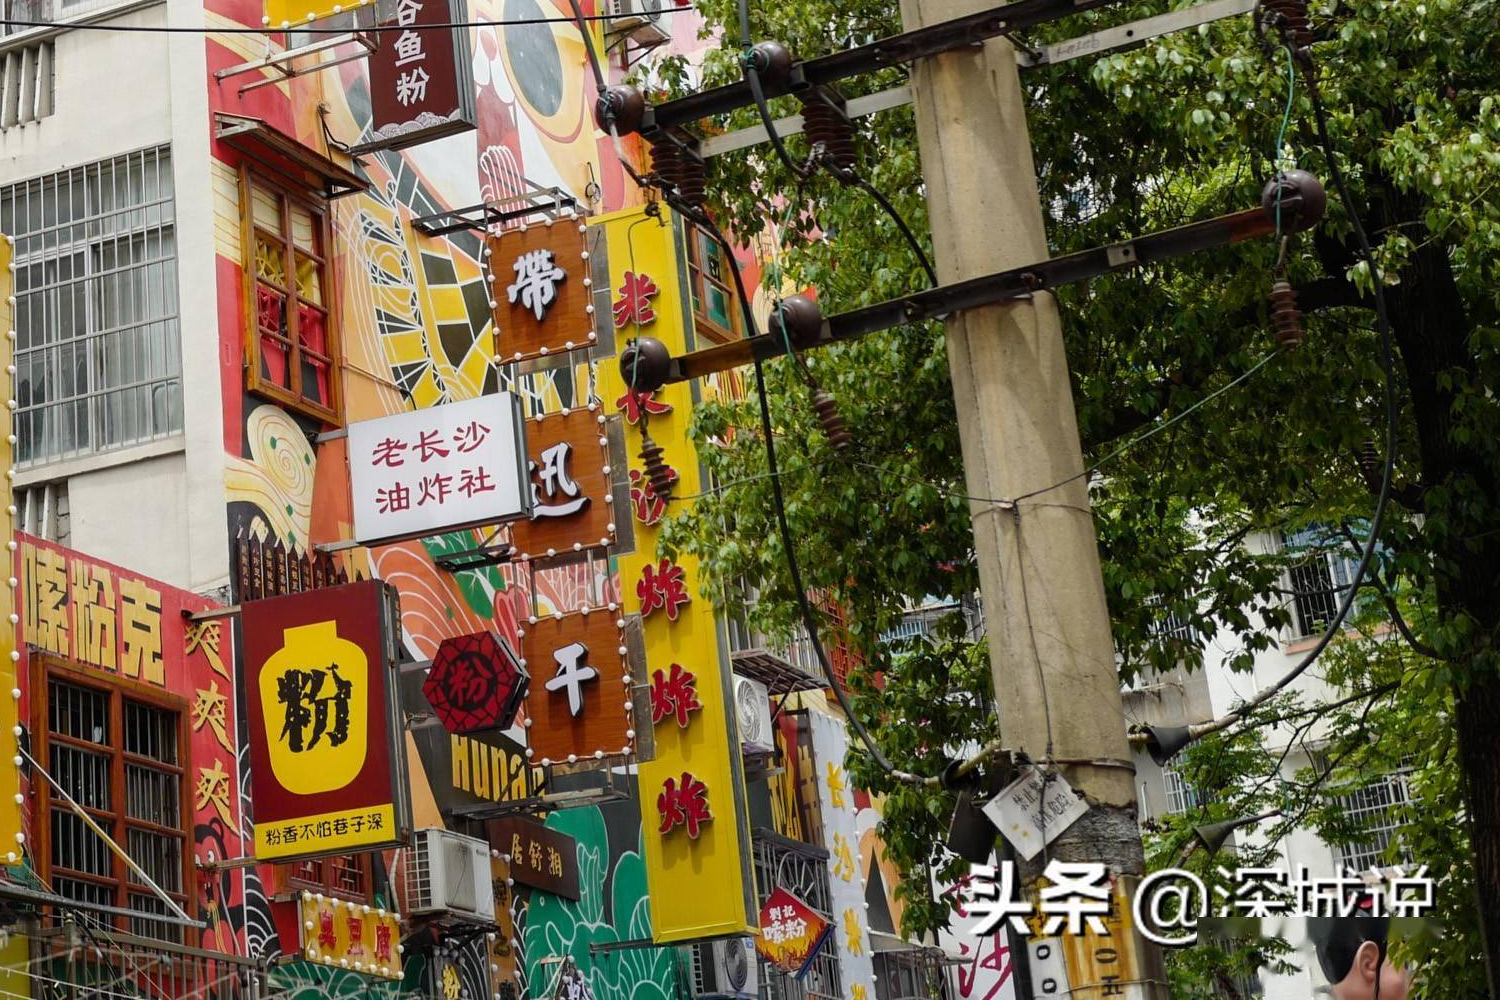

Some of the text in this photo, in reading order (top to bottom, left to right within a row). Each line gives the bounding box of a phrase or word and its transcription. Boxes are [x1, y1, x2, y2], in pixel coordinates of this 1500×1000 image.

[372, 421, 491, 468] 老长沙
[375, 466, 496, 514] 油炸社
[448, 656, 493, 707] 粉
[184, 604, 241, 840] 爽爽爽
[277, 661, 352, 753] 粉
[265, 812, 384, 846] 粉香不怕巷子深
[318, 909, 393, 964] 臭豆腐
[761, 917, 808, 944] 嗦粉
